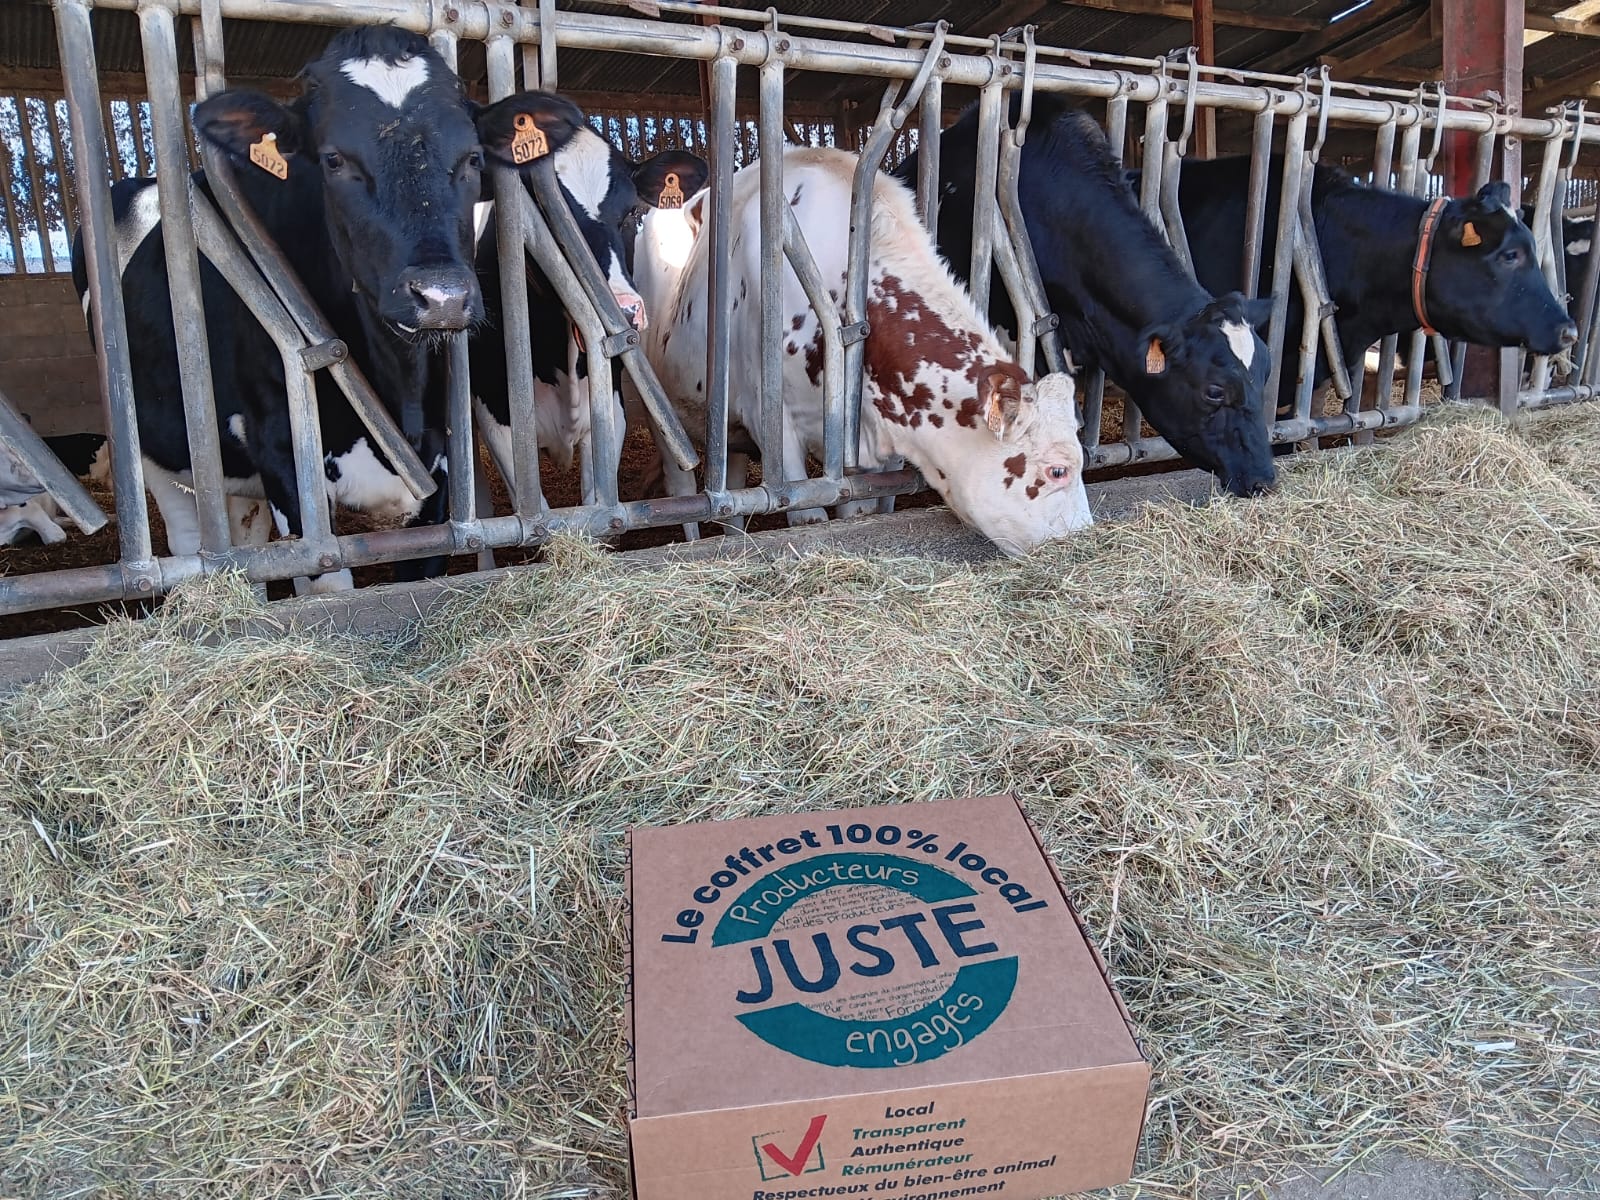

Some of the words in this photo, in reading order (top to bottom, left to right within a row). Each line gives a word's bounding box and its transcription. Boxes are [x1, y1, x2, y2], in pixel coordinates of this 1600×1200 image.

[514, 137, 546, 162] 5072
[661, 909, 704, 944] Le
[693, 829, 822, 904] coffret
[826, 823, 939, 854] 100%
[944, 842, 1049, 913] local
[729, 862, 919, 925] Producteurs
[736, 903, 999, 1004] JUSTE
[845, 992, 985, 1067] engagés
[885, 1101, 935, 1119] Local
[850, 1135, 965, 1158] Authentique
[852, 1118, 967, 1140] Transparent
[752, 1183, 869, 1200] Respectueux
[874, 1178, 898, 1191] du
[904, 1167, 988, 1188] bien-être
[993, 1154, 1057, 1175] animal
[841, 1151, 974, 1177] Rémunérateur
